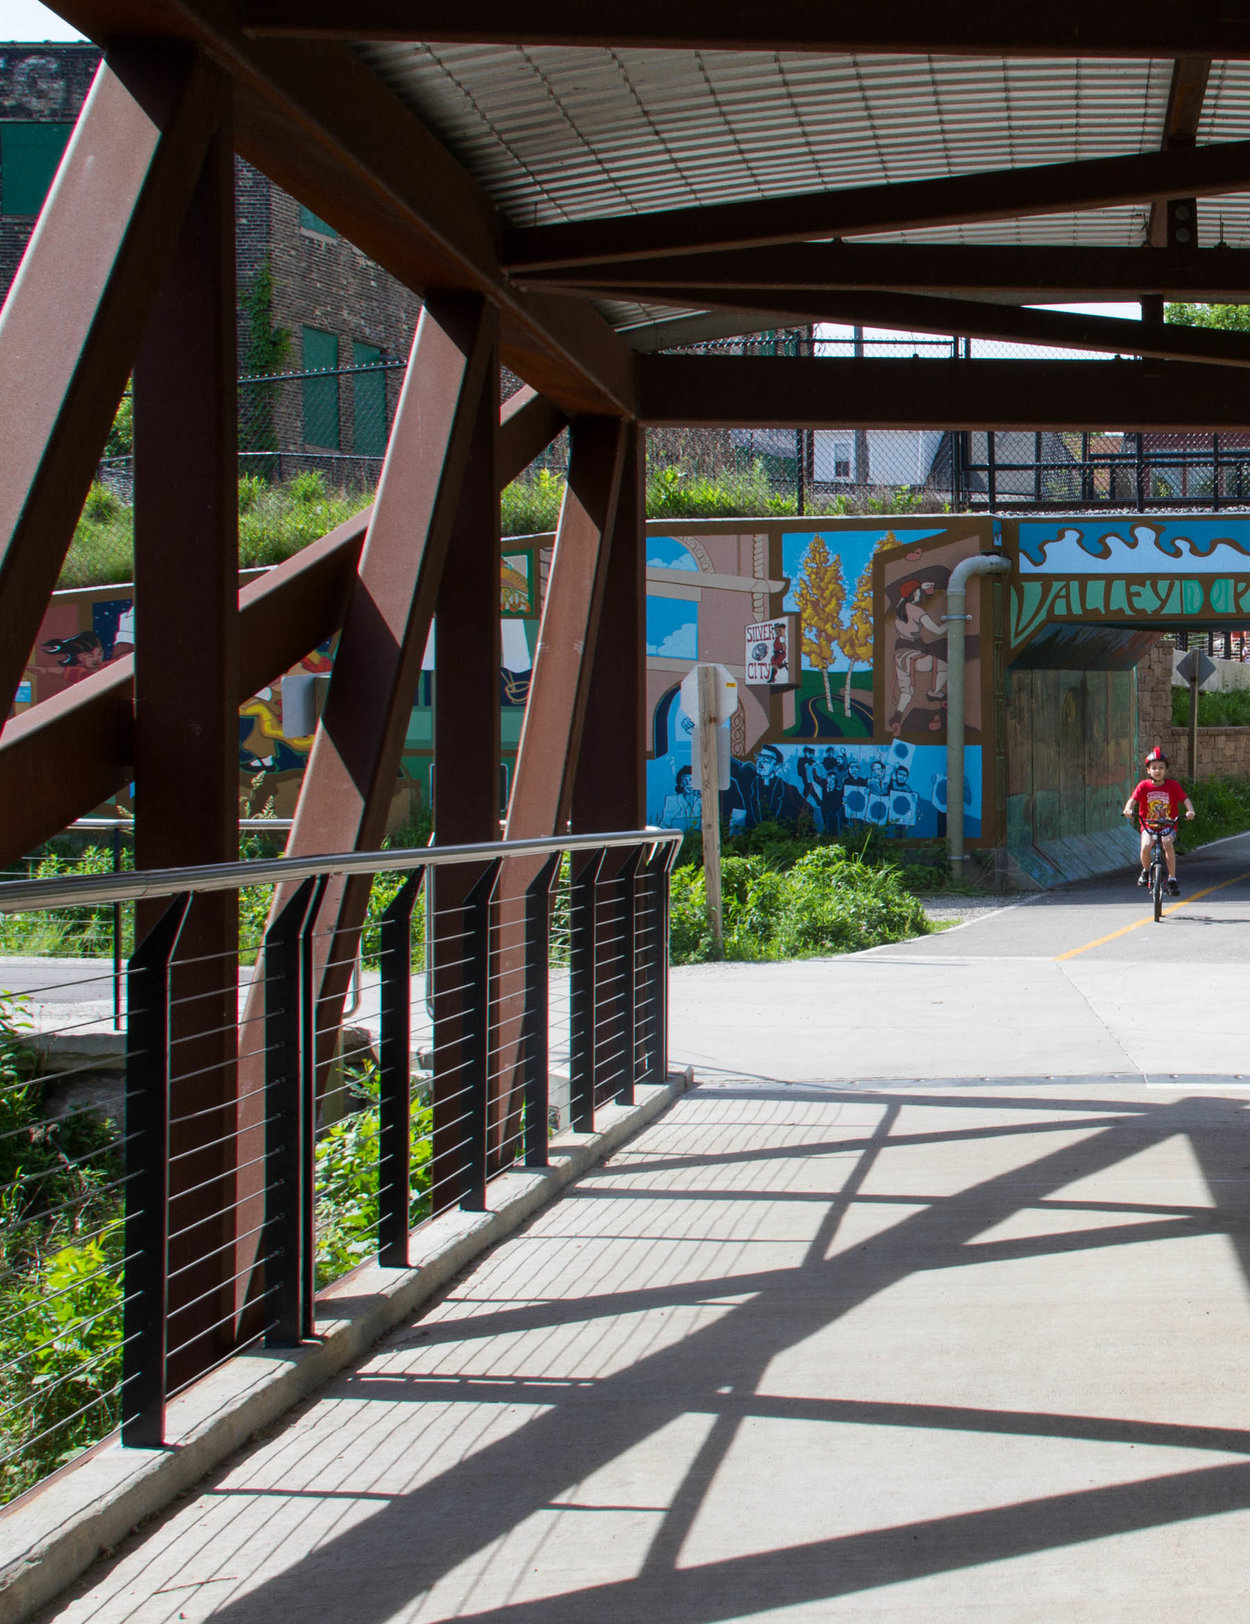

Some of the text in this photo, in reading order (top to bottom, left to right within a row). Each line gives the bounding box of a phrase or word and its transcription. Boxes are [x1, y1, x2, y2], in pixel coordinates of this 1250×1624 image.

[1011, 579, 1178, 642] VALLEY
[747, 624, 775, 642] SILVER
[748, 662, 771, 680] CITY
